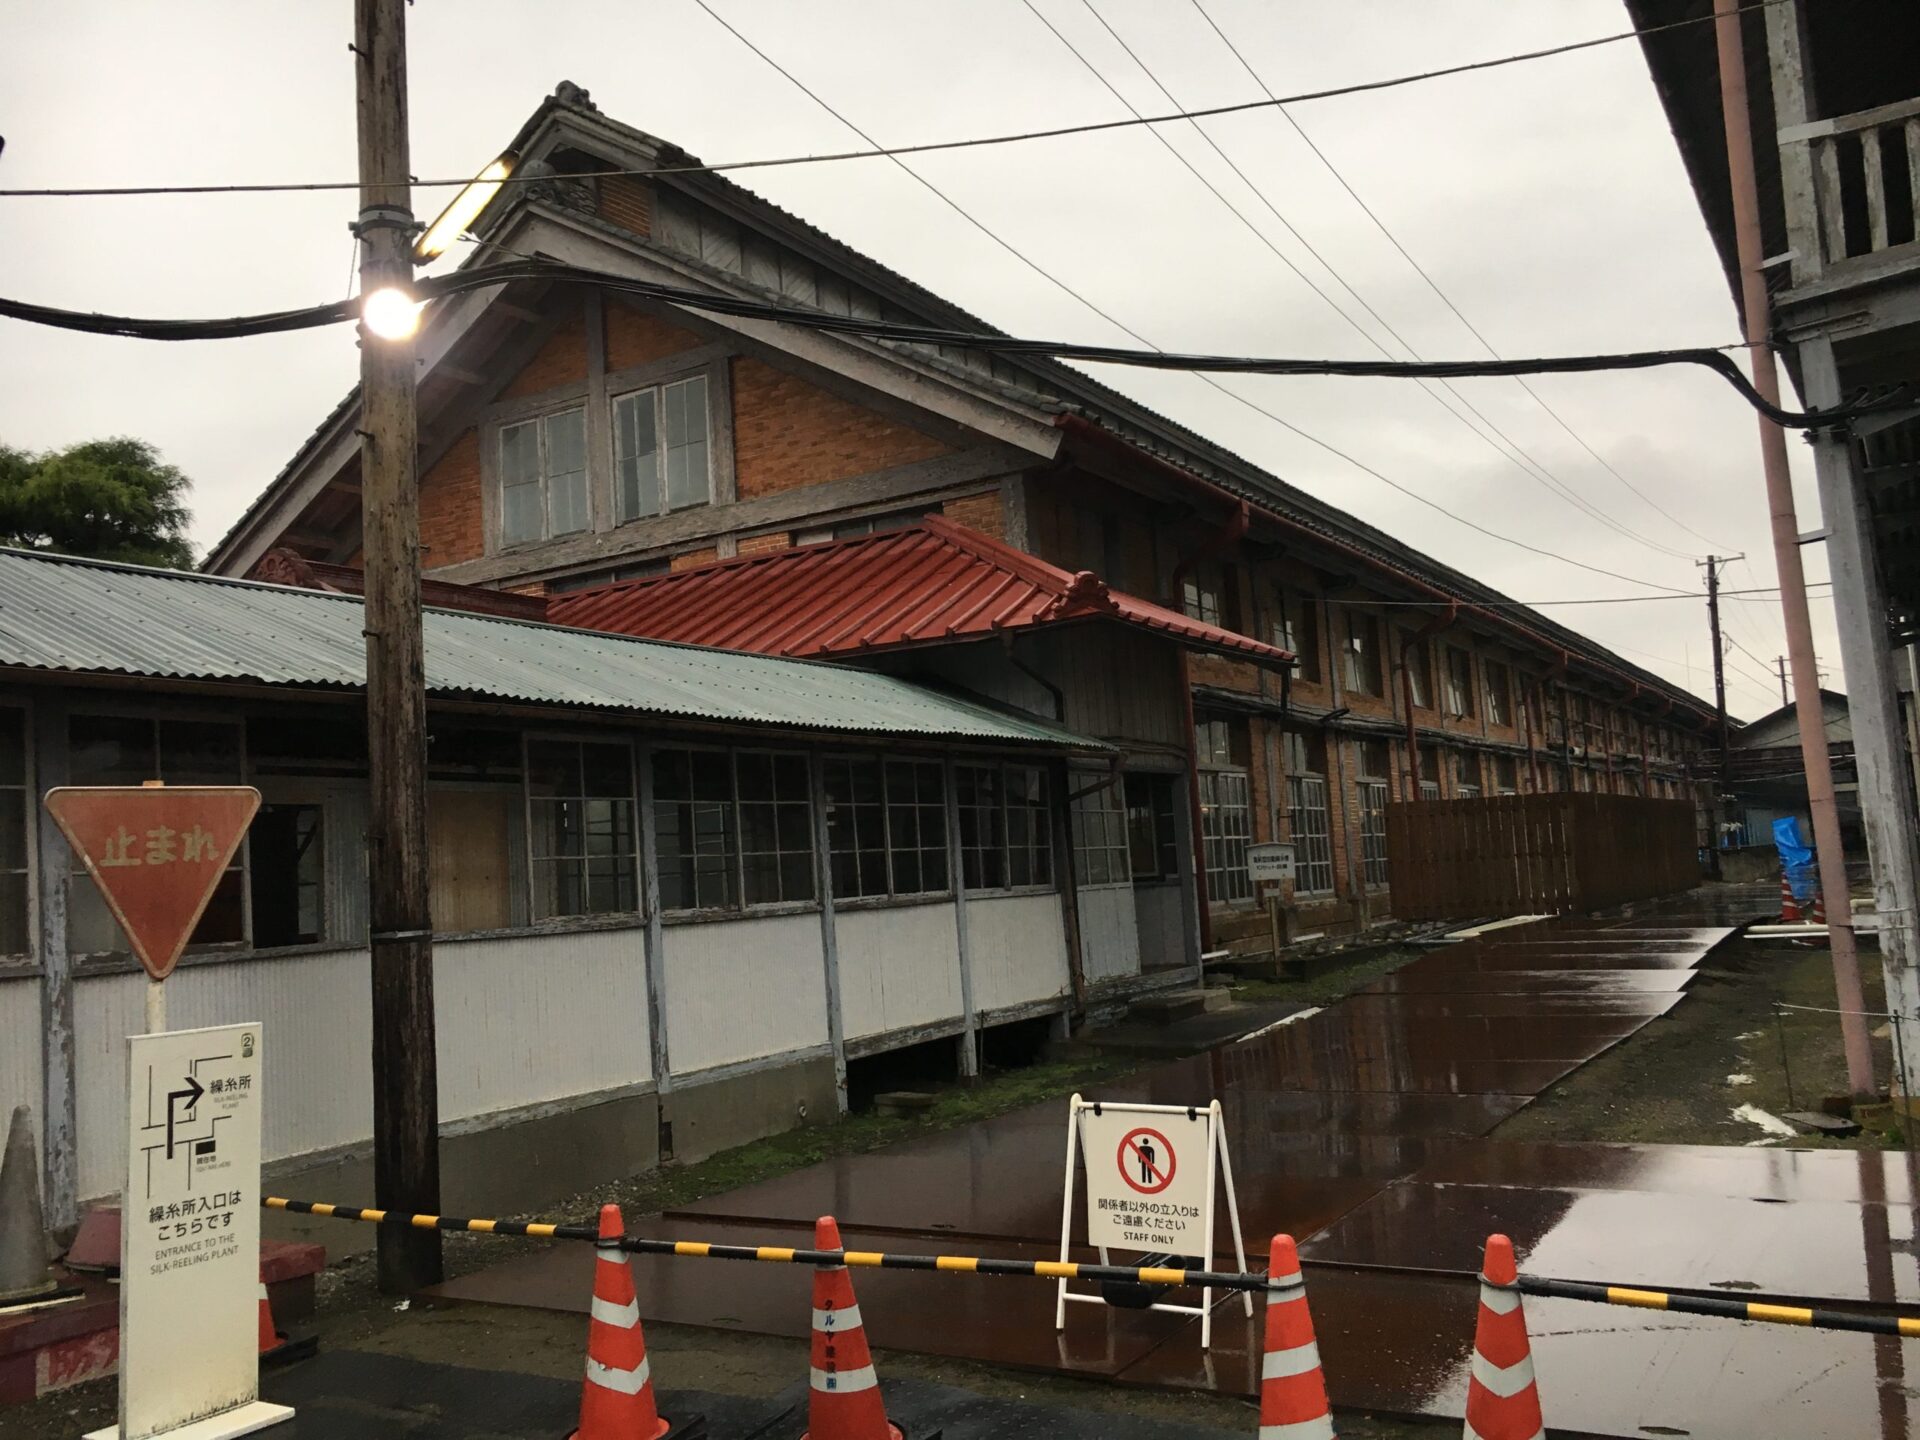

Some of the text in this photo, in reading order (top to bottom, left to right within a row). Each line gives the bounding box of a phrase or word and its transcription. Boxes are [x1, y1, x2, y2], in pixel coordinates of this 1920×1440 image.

[99, 824, 220, 868] 止まれ
[210, 1075, 252, 1094] 繰糸所
[149, 1190, 242, 1223] 繰糸所入口は
[1098, 1198, 1200, 1218] 関係者以外の立入りは
[158, 1211, 234, 1241] こちらです
[1113, 1214, 1186, 1231] ご遠慮ください
[155, 1233, 235, 1260] ENTRANCE TO THE
[1123, 1231, 1174, 1245] STAFF ONLY
[150, 1245, 239, 1275] SILK-REELING PLANT
